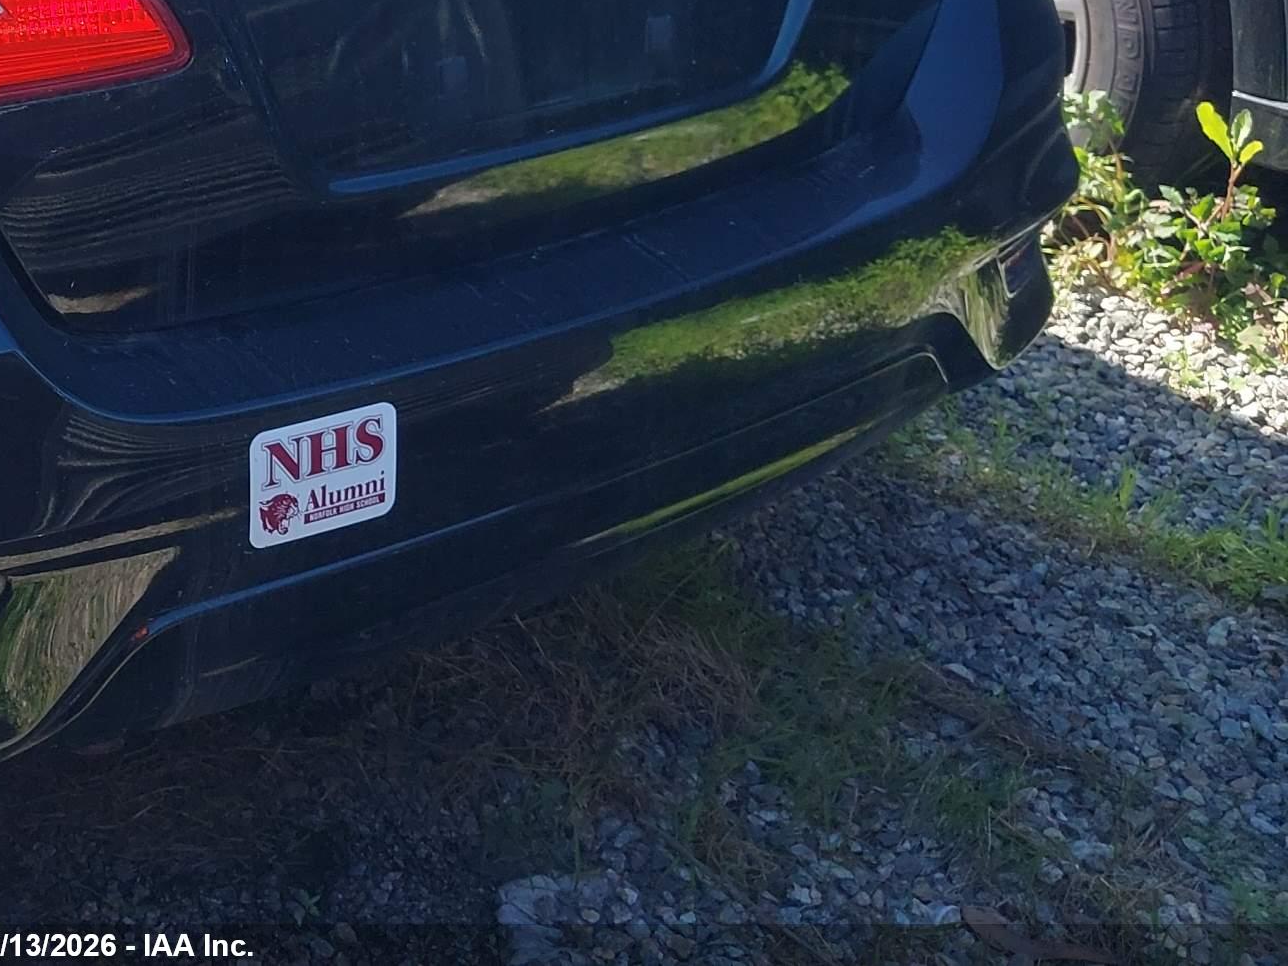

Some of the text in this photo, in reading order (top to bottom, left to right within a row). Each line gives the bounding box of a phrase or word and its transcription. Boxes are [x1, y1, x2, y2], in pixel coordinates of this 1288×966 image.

[263, 416, 384, 489] NHS
[304, 470, 385, 512] Alumni
[356, 496, 380, 509] SCHOOL
